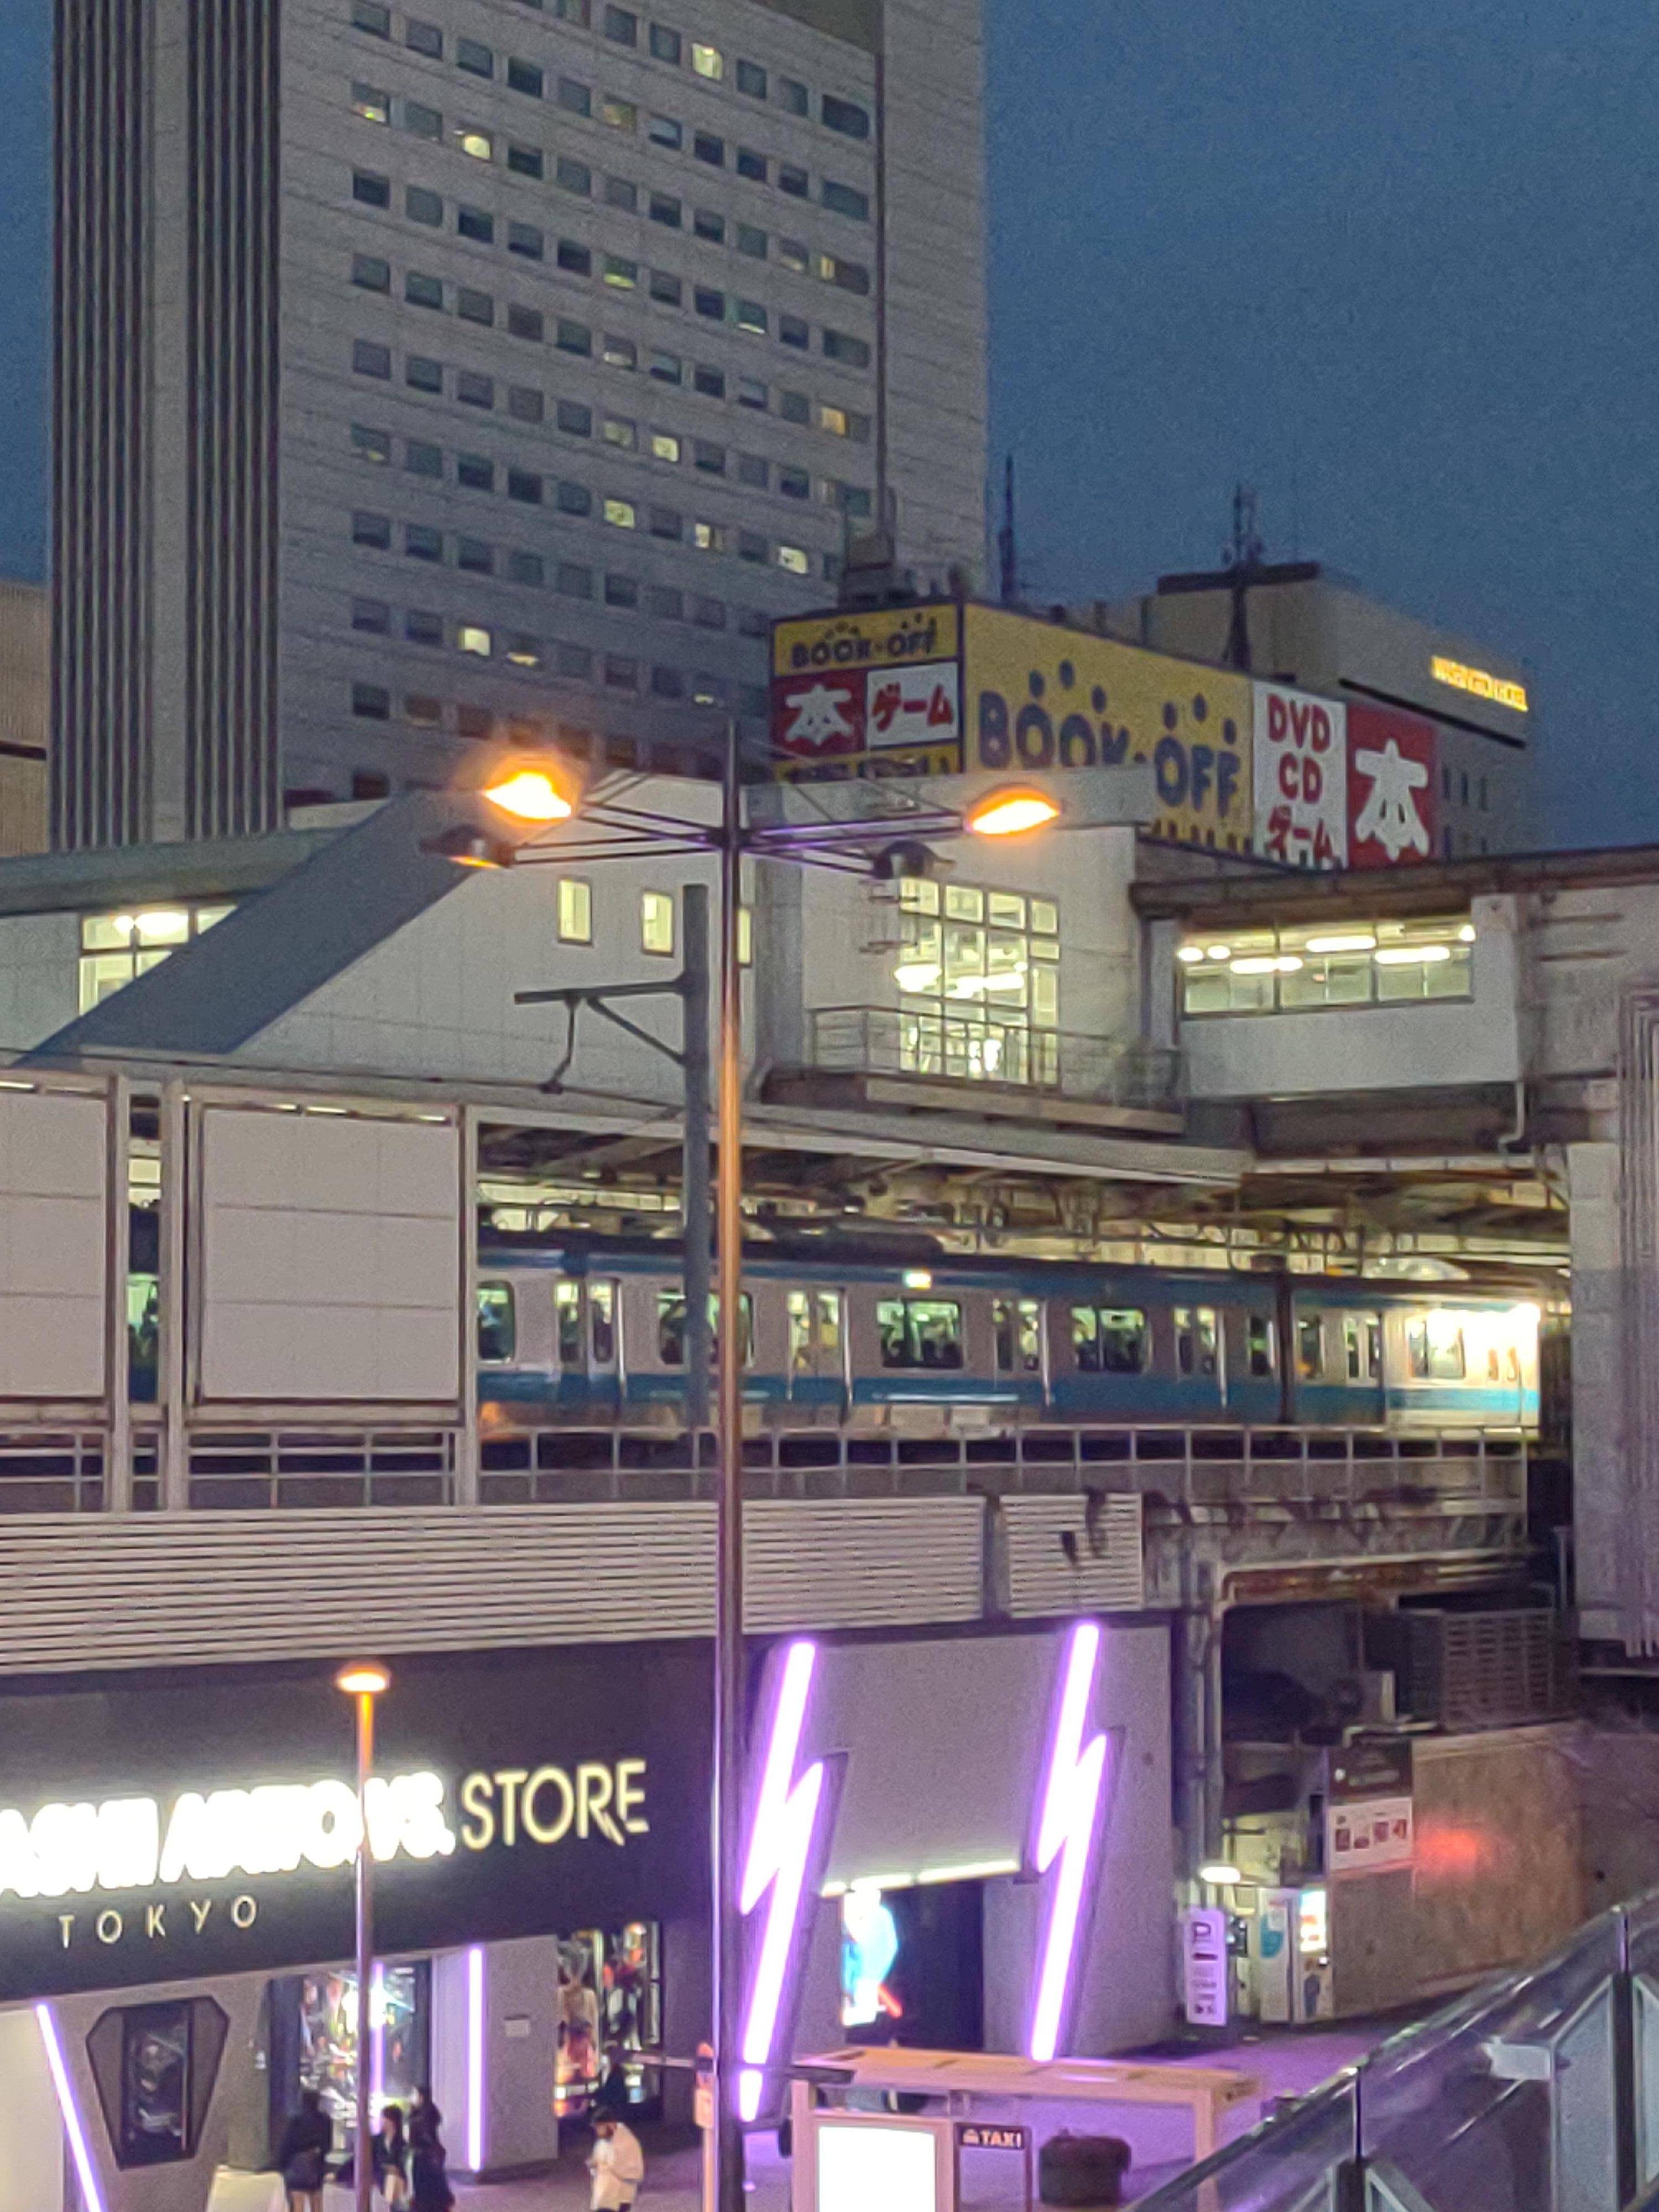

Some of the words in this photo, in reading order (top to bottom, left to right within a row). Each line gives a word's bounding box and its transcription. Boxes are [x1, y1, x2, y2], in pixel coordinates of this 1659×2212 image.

[785, 684, 854, 747] 本
[1267, 693, 1331, 753] DVD
[1153, 735, 1240, 818] OFF
[1279, 752, 1323, 804] CD
[1355, 738, 1430, 862] 本
[461, 1759, 650, 1850] STORE
[59, 1894, 257, 1949] TOKYO
[980, 2128, 1021, 2148] TAXI
